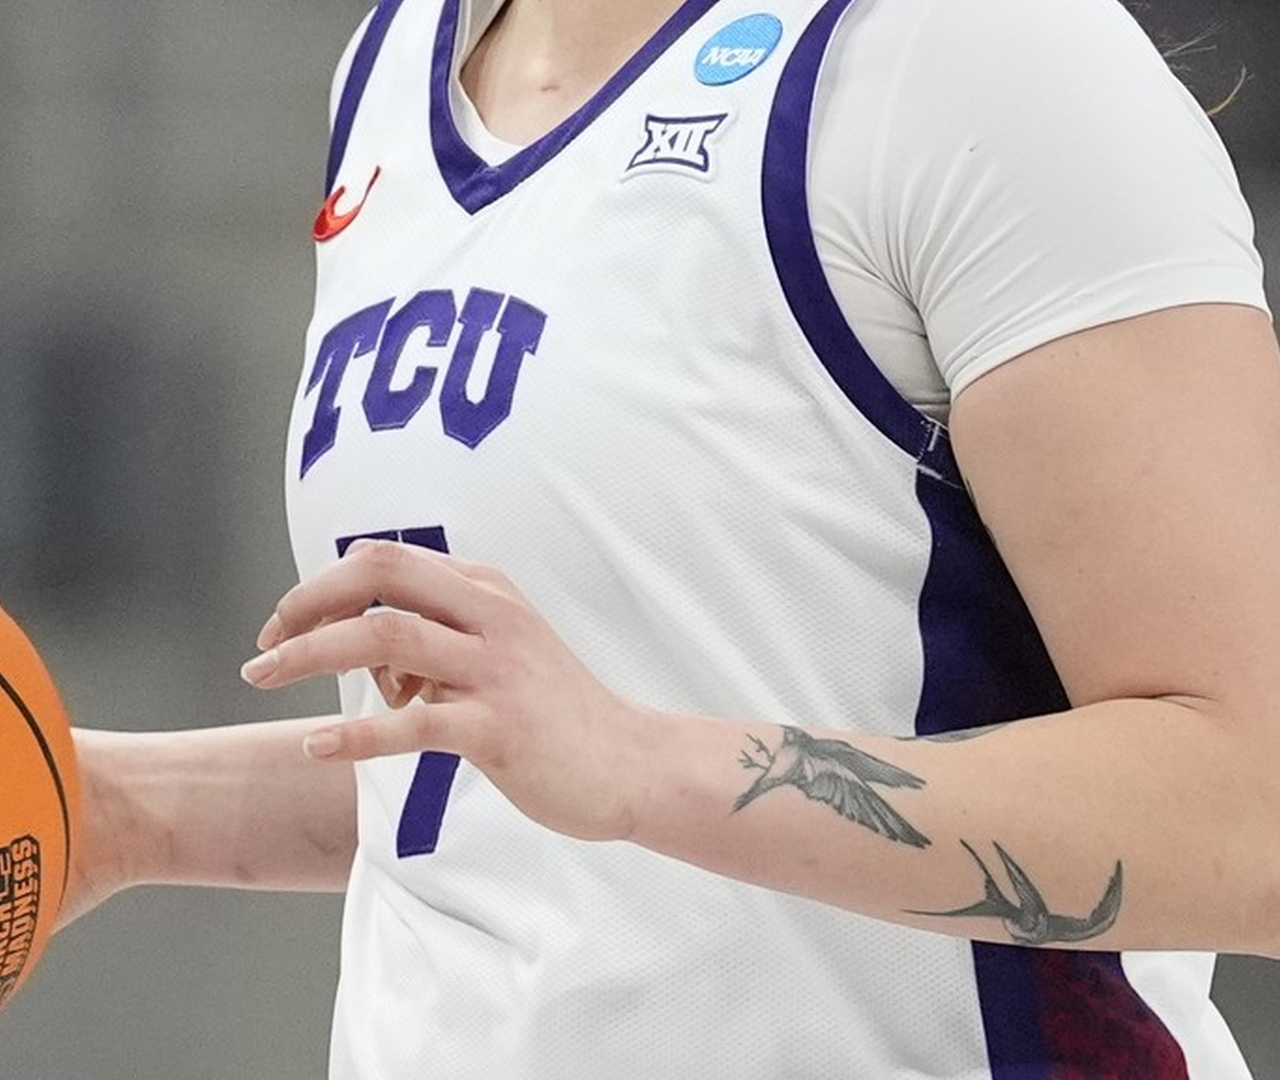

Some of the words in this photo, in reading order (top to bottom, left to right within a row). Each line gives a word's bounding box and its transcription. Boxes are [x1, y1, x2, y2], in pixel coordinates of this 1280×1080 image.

[700, 46, 767, 68] NCAA
[628, 115, 724, 170] XII
[300, 287, 548, 481] TCU
[0, 838, 36, 979] MADNESS
